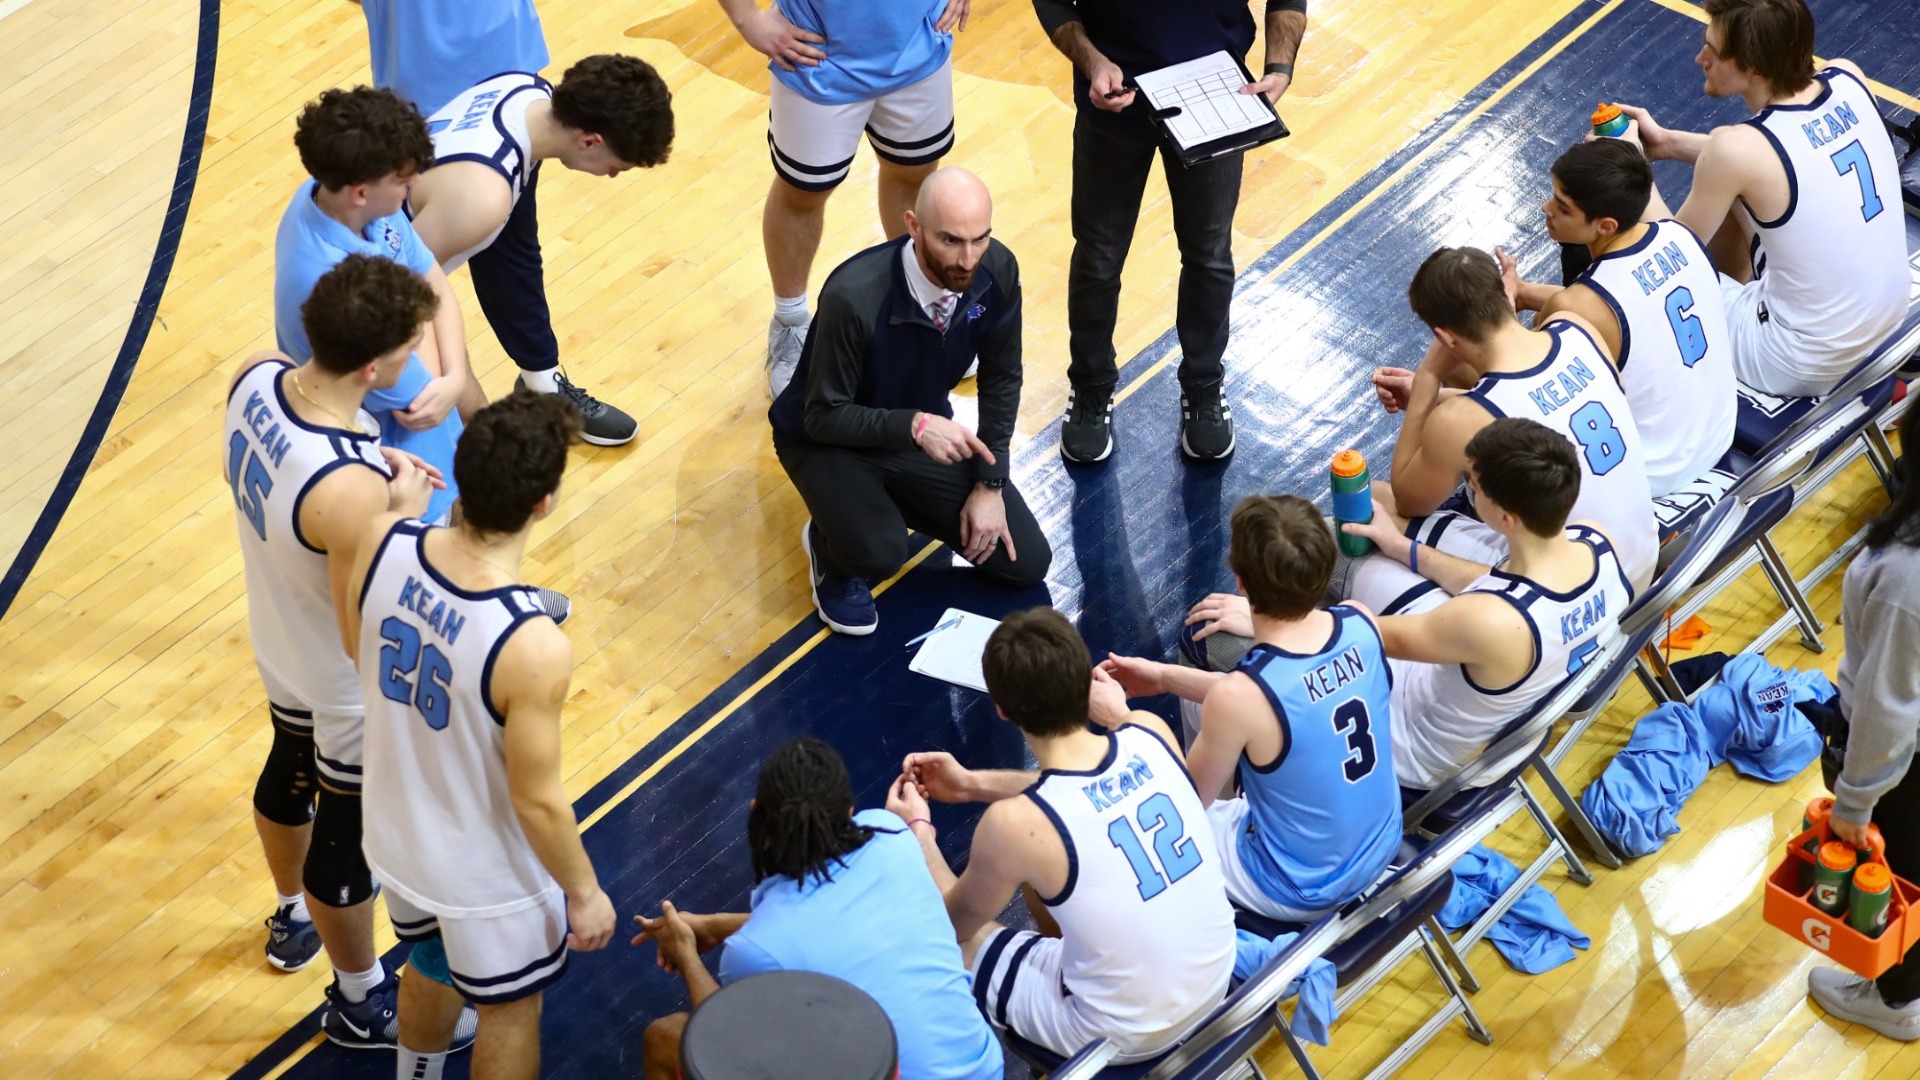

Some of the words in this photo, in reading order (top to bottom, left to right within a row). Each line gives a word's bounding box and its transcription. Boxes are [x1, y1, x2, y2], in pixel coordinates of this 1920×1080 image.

[450, 89, 502, 133] KEAN
[1801, 100, 1859, 150] KEAN
[1830, 138, 1884, 223] 7
[1631, 240, 1688, 296] KEAN
[1664, 285, 1708, 369] 6
[1528, 356, 1596, 416] KEAN
[243, 389, 293, 470] KEAN
[1568, 400, 1627, 476] 8
[229, 428, 274, 542] 15
[397, 575, 466, 646] KEAN
[1560, 588, 1606, 645] KEAN
[379, 615, 453, 731] 26
[1302, 645, 1365, 704] KEAN
[1756, 685, 1790, 703] KEAN
[1331, 695, 1378, 785] 3
[1082, 752, 1154, 814] KEAN
[1107, 791, 1204, 903] 12
[1802, 917, 1833, 952] G
